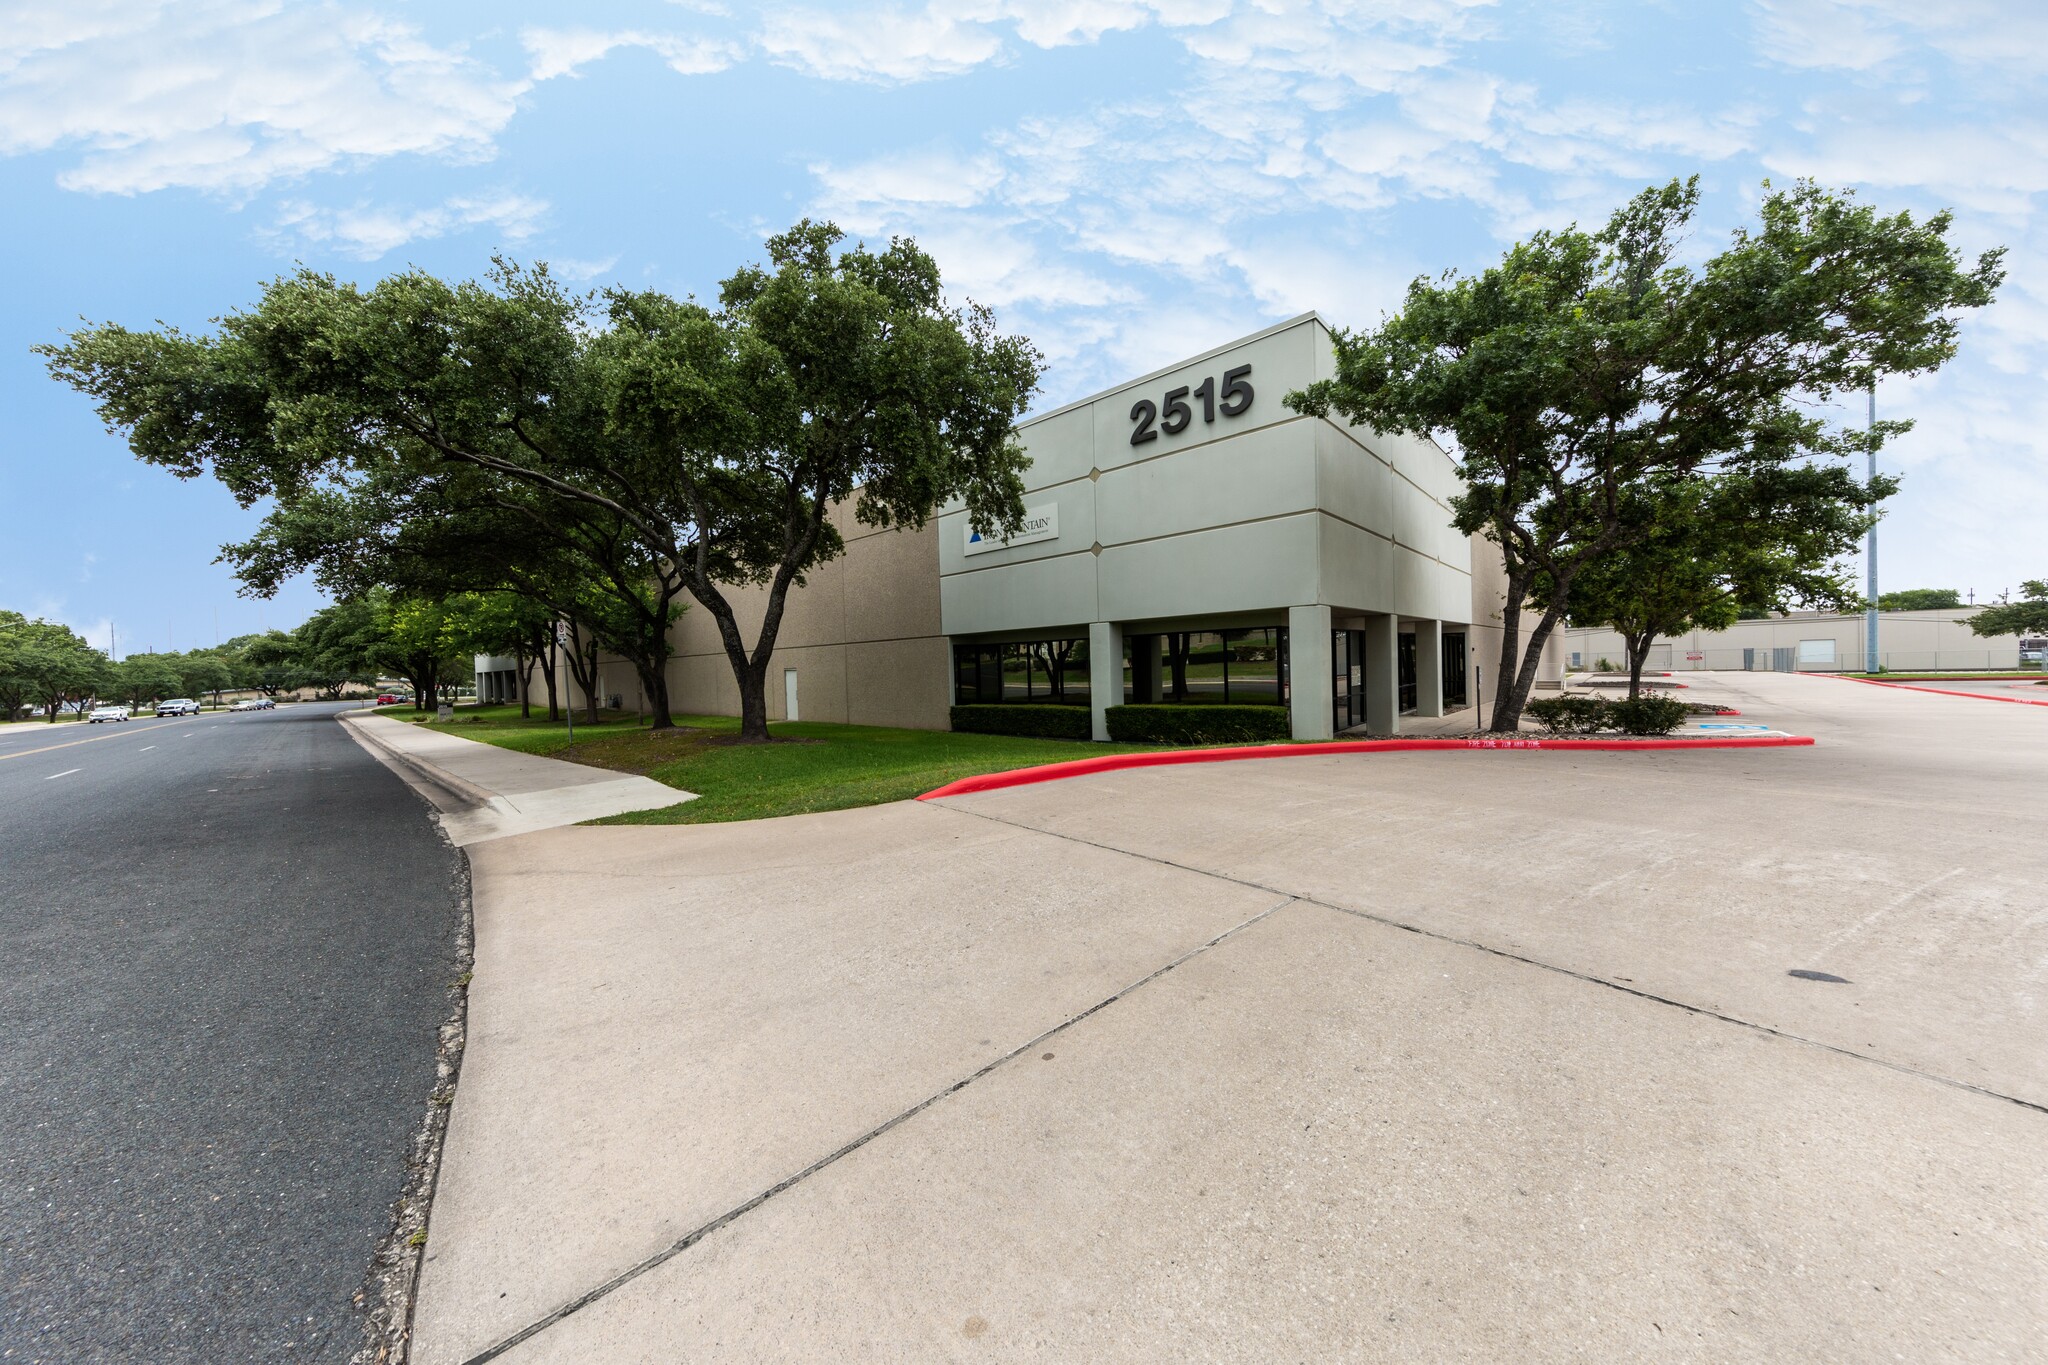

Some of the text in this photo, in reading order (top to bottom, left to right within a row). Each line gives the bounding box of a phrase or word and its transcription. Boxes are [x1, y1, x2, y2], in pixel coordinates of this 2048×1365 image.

[1130, 363, 1255, 446] 2515
[1468, 740, 1480, 748] FIRE
[1482, 740, 1497, 748] ZONE
[1526, 740, 1541, 748] ZONE
